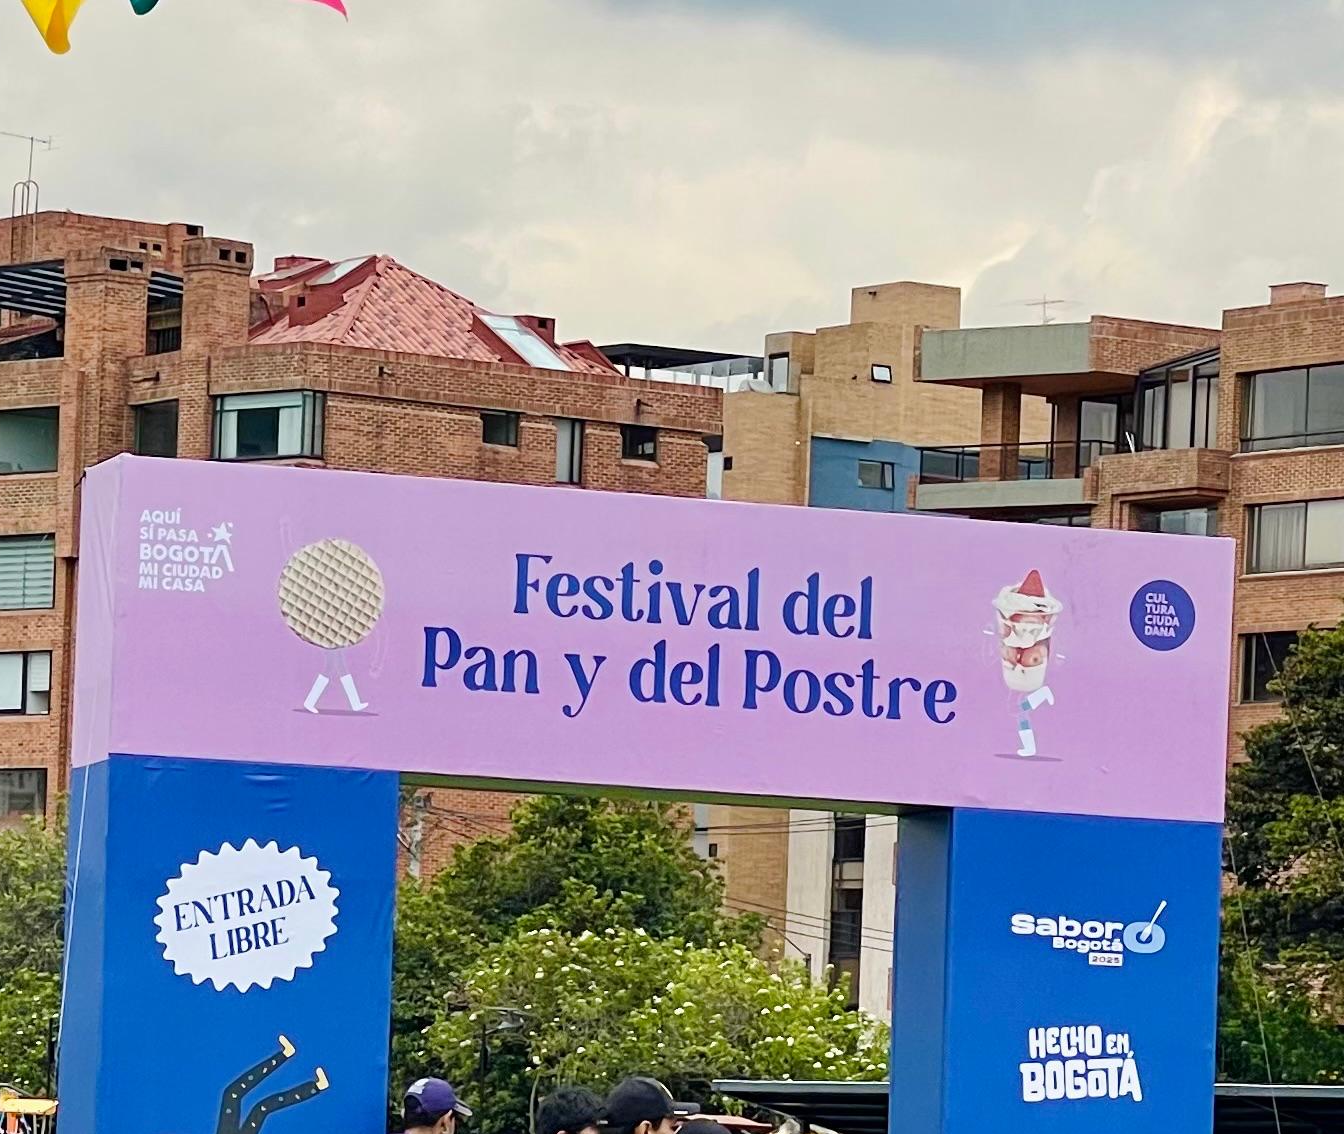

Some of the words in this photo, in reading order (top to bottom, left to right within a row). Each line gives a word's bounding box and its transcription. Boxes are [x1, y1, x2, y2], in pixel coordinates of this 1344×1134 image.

[140, 508, 182, 524] AQUÍ
[139, 524, 155, 541] SÍ
[158, 527, 199, 542] PASA
[138, 575, 158, 590] MI
[162, 577, 205, 593] CASA
[139, 561, 158, 576] MI
[162, 563, 223, 580] CIUDAD
[513, 550, 760, 633] Festival
[782, 571, 874, 641] del
[421, 625, 541, 695] Pan
[562, 653, 607, 719] y
[628, 634, 720, 708] del
[742, 648, 957, 725] Postre
[173, 872, 317, 933] ENTRADA
[209, 916, 290, 961] LIBRE
[1010, 913, 1124, 940] Sabor
[1052, 936, 1124, 954] Bogotá
[1028, 1025, 1103, 1060] HECHO
[1105, 1033, 1130, 1055] EN
[1019, 1050, 1144, 1103] BOGOTÁ
